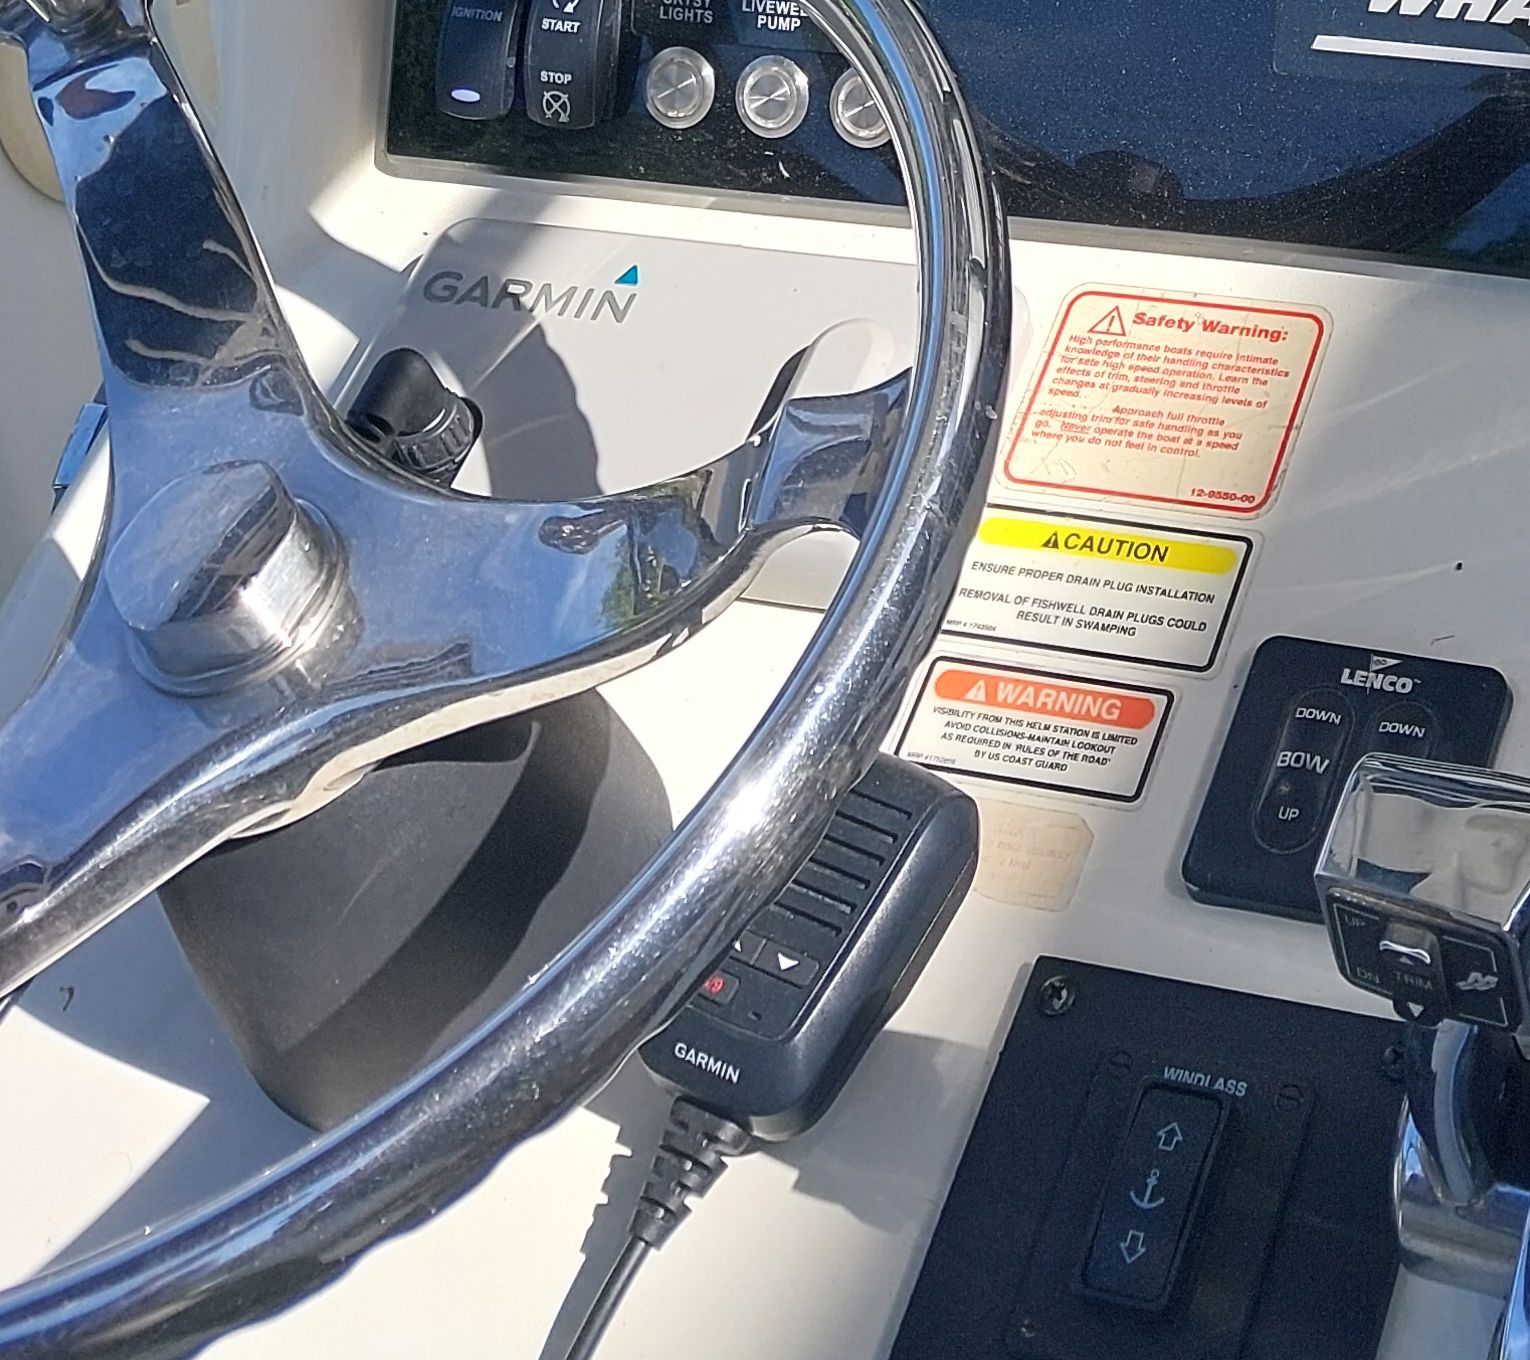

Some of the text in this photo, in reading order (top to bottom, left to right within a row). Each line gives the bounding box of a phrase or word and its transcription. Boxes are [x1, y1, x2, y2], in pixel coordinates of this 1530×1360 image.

[450, 7, 502, 22] IGNITION
[541, 18, 580, 33] START
[659, 5, 713, 24] LIGHTS
[757, 15, 801, 32] PUMP
[540, 71, 572, 84] STOP
[423, 270, 637, 324] GARMIN
[1132, 311, 1288, 342] Safety Warning:
[1064, 345, 1290, 378] knowledge their handling characteristics
[1069, 334, 1278, 366] High performance boats require intimate
[1056, 365, 1091, 378] effects
[1094, 369, 1106, 378] of
[1134, 375, 1176, 390] steering
[1179, 379, 1200, 390] and
[1202, 382, 1240, 394] throttle
[1102, 359, 1125, 372] high
[1128, 362, 1160, 376] speed
[1218, 373, 1249, 386] Learn
[1252, 376, 1268, 387] the
[1052, 375, 1268, 409] changes gradually increasing levels of
[1039, 408, 1243, 440] adjusting trim safe handling as you
[1112, 405, 1225, 427] Approach full throttle
[1032, 429, 1063, 440] where
[1065, 435, 1085, 445] you
[1088, 436, 1102, 446] do
[1104, 438, 1122, 448] not
[1125, 440, 1145, 450] feel
[1061, 421, 1239, 452] Never operate the boat speed
[1063, 533, 1170, 563] CAUTION
[971, 560, 1215, 604] ENSURE PROPER DRAIN PLUG INSTALLATION
[959, 587, 1207, 632] REMOVAL OF FISHWELL DRAIN PLUGS COULD
[1016, 610, 1136, 637] RESULT IN SWAMPING
[1340, 668, 1414, 694] LENCO
[996, 682, 1122, 721] WARNING
[1295, 707, 1342, 725] DOWN
[933, 706, 1138, 746] VISIBILITY FROM THIS HELM STATION IS LIMITED
[944, 720, 972, 731] AVOID
[1071, 738, 1116, 755] LOOKOUT
[1378, 721, 1425, 738] DOWN
[941, 732, 954, 741] AS
[955, 733, 1001, 749] REQUIRED
[1002, 740, 1012, 750] IN
[1047, 747, 1060, 757] OF
[1062, 749, 1080, 762] THE
[974, 749, 1068, 772] BY US COAST GUARD
[1276, 751, 1330, 774] BOW
[1278, 806, 1299, 821] UP
[674, 1042, 740, 1084] GARMIN
